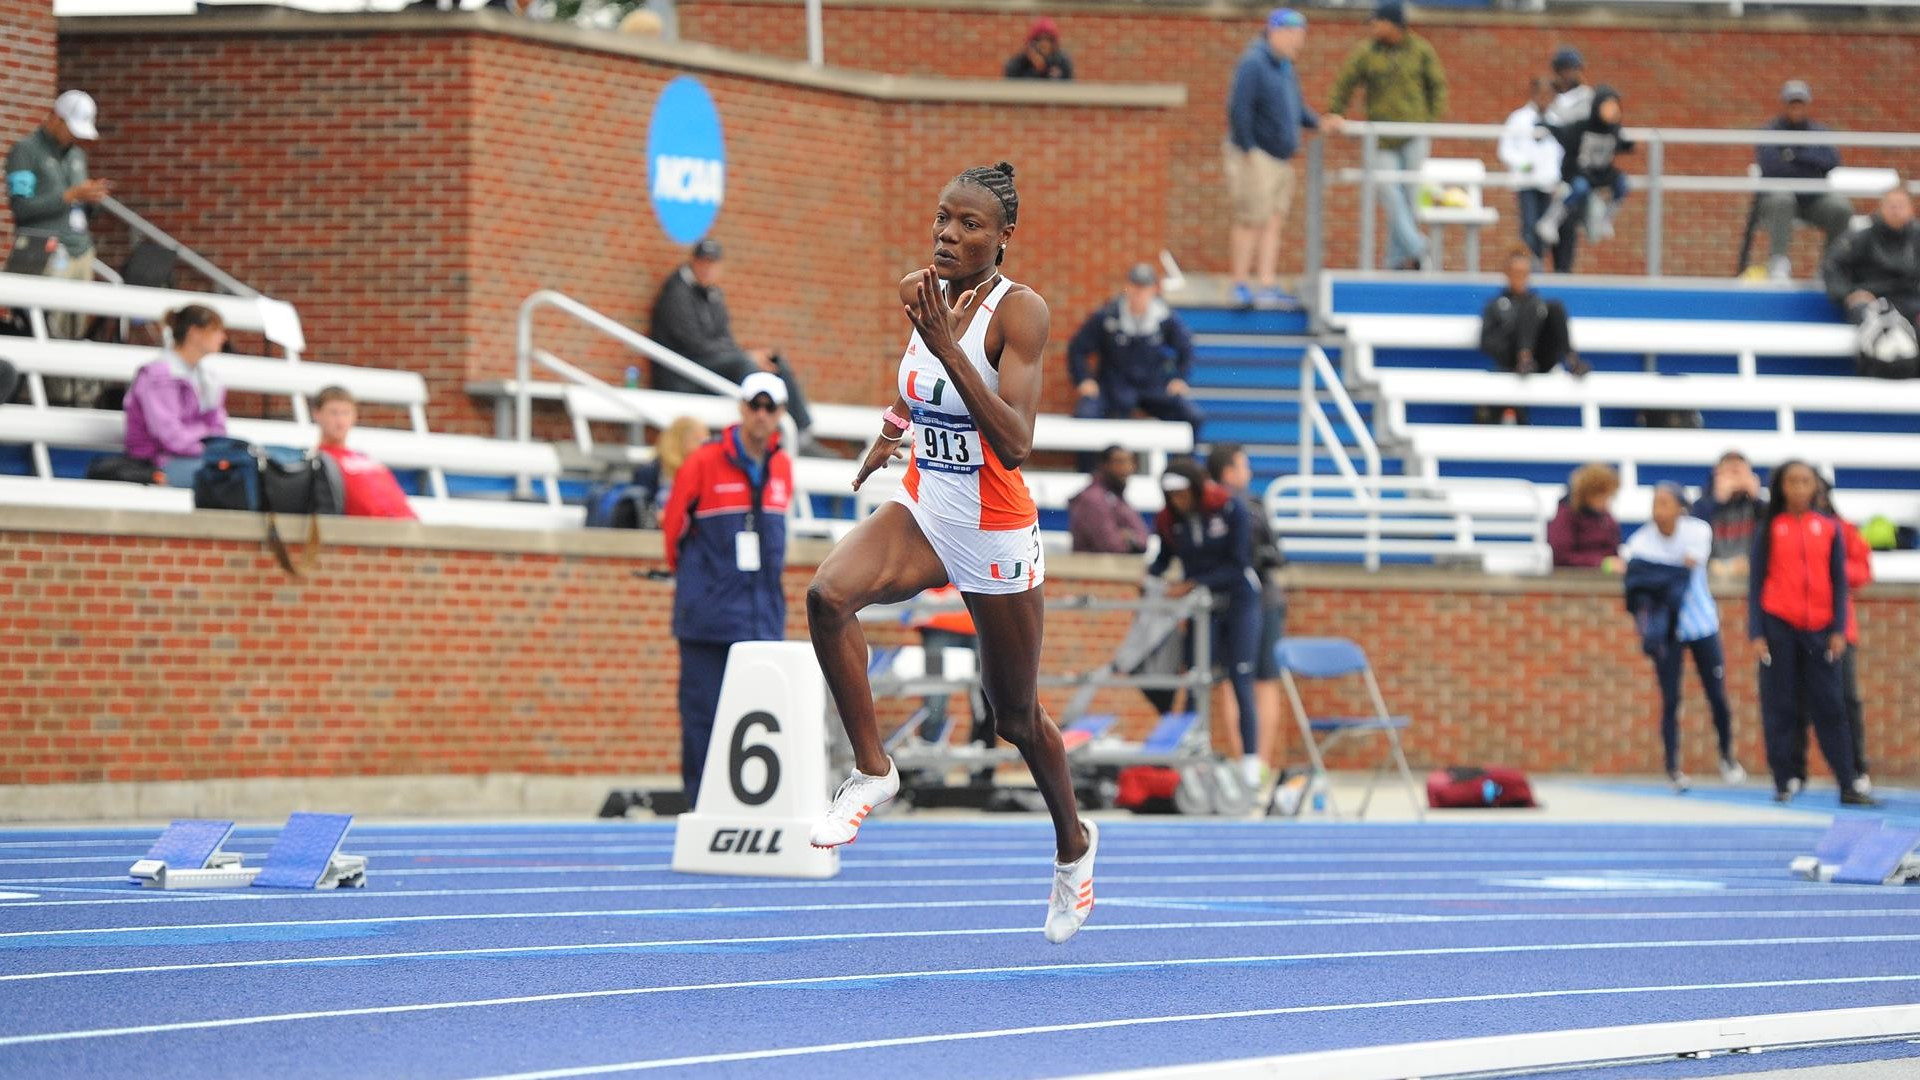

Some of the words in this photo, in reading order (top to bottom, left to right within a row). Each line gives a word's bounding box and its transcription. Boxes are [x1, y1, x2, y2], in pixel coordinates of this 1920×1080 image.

[654, 155, 724, 206] NCAA
[907, 371, 946, 406] U
[924, 427, 970, 463] 913
[990, 561, 1022, 580] U
[729, 711, 782, 806] 6
[709, 829, 783, 854] GILL
